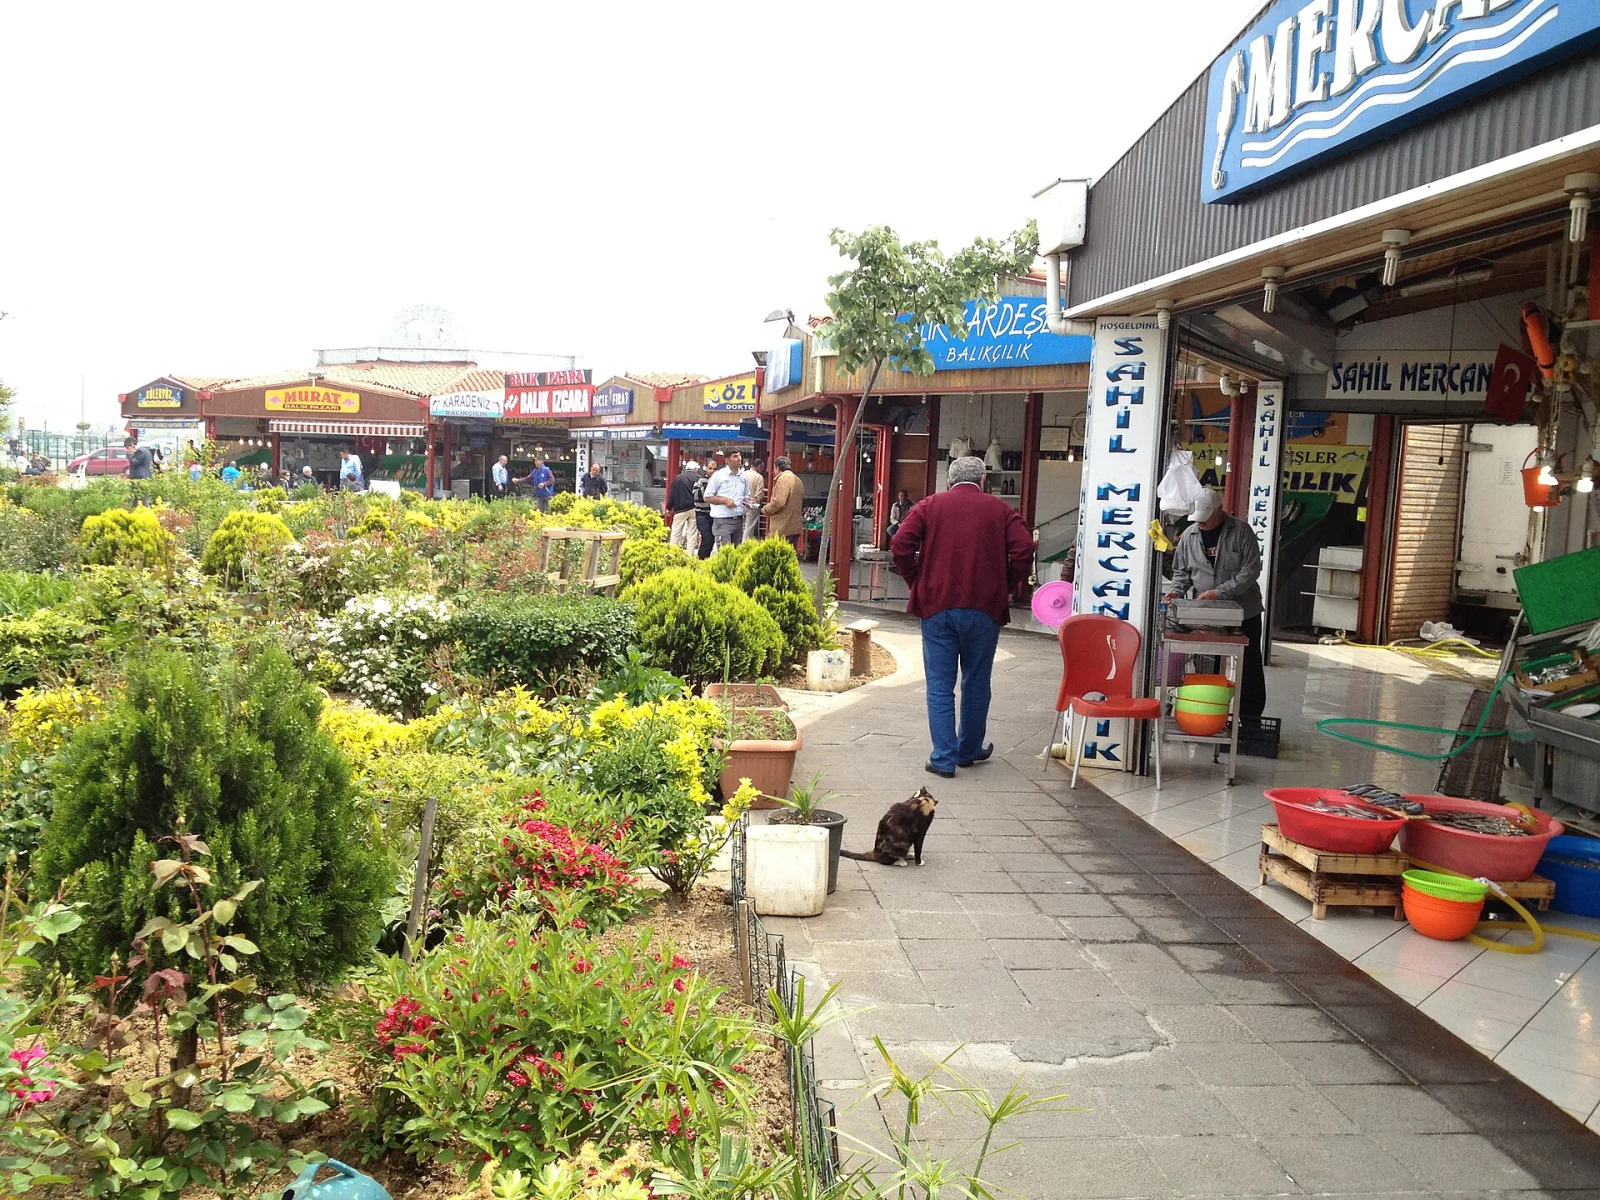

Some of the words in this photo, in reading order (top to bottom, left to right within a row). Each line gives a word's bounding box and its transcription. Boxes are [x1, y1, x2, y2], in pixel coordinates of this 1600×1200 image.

[946, 343, 1032, 363] BALIKÇILIK
[510, 373, 539, 387] BALIK
[1332, 356, 1392, 394] SAHİL
[1399, 362, 1494, 395] MERCAN
[284, 391, 341, 404] MURAT
[520, 390, 549, 414] BALIK
[552, 388, 589, 413] IZGARA
[722, 383, 746, 401] ÖZ
[1106, 336, 1146, 453] SAHİL
[443, 395, 490, 410] KARADENİZ
[1092, 482, 1141, 620] MERCAN
